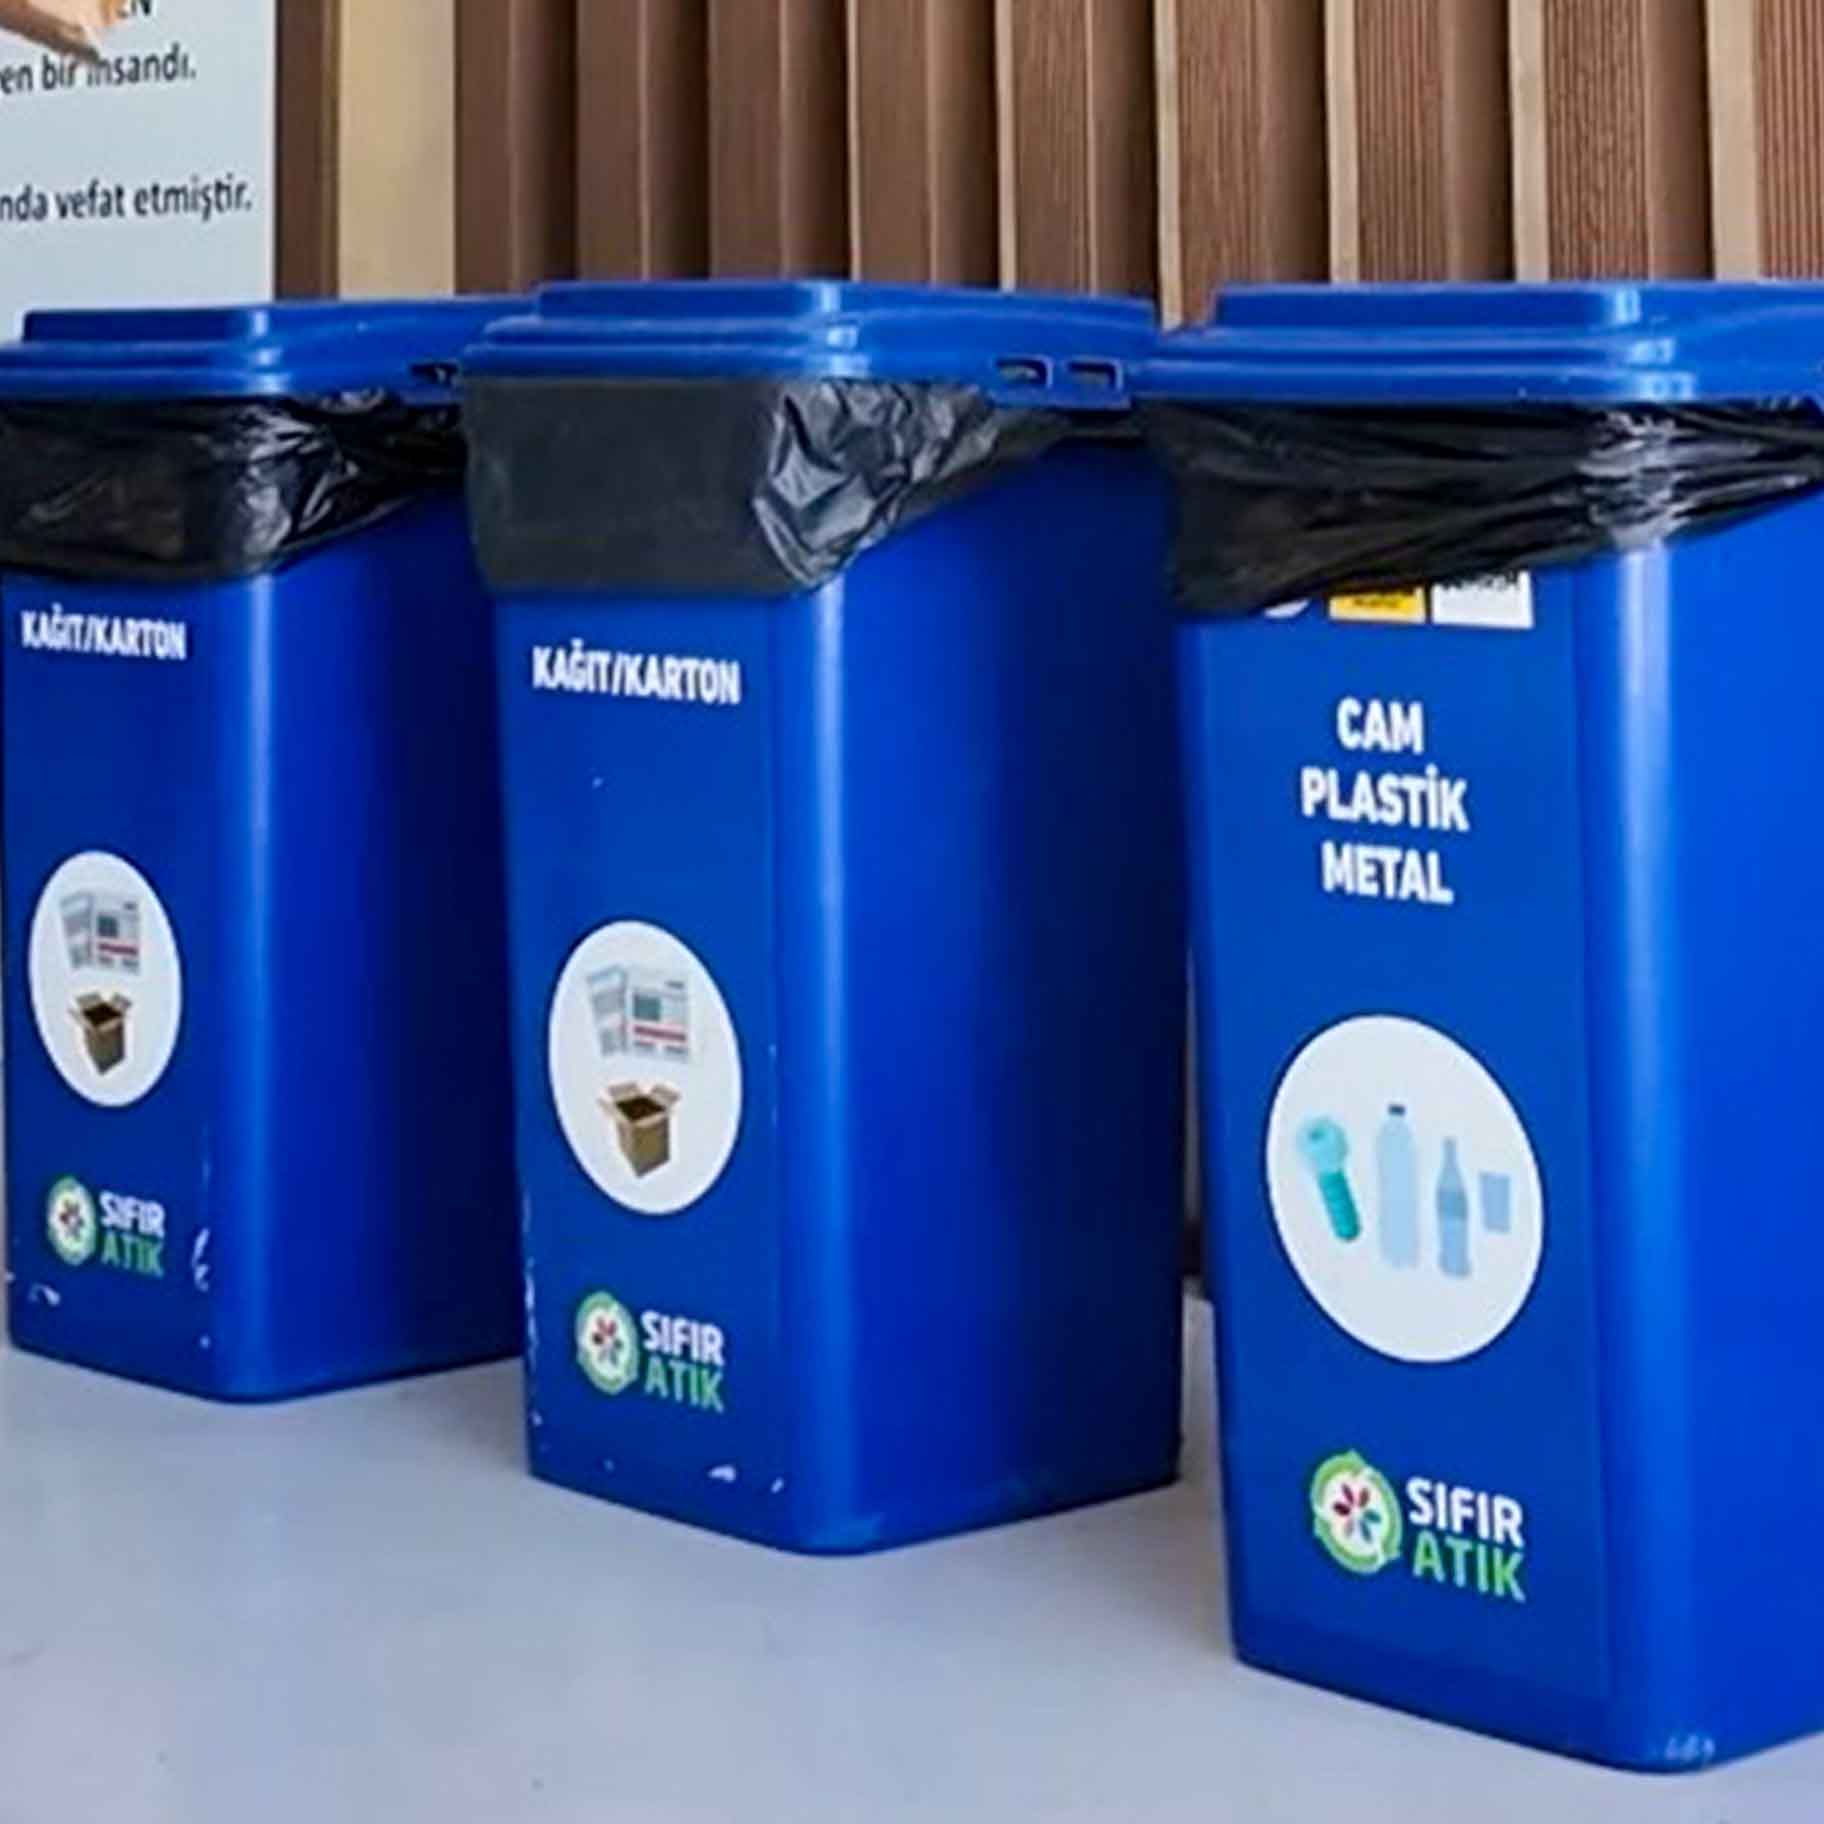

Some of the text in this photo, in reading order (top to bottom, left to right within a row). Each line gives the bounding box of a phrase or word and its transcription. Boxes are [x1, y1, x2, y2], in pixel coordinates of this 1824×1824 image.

[41, 52, 79, 92] bir
[55, 177, 127, 219] vefat
[133, 172, 253, 222] etmiştir.
[21, 603, 187, 660] KAĞIT/KARTON
[532, 639, 741, 704] KAĞIT/KARTON
[1336, 697, 1424, 755] CAM
[1300, 763, 1470, 832] PLASTİK
[1321, 840, 1455, 905] METAL
[99, 1190, 166, 1236] SIFIR
[101, 1232, 164, 1277] ATIK
[640, 1309, 724, 1366] SIFIR
[644, 1359, 724, 1413] ATIK
[1406, 1477, 1526, 1547] SIFIR
[1411, 1529, 1526, 1603] ATIK
